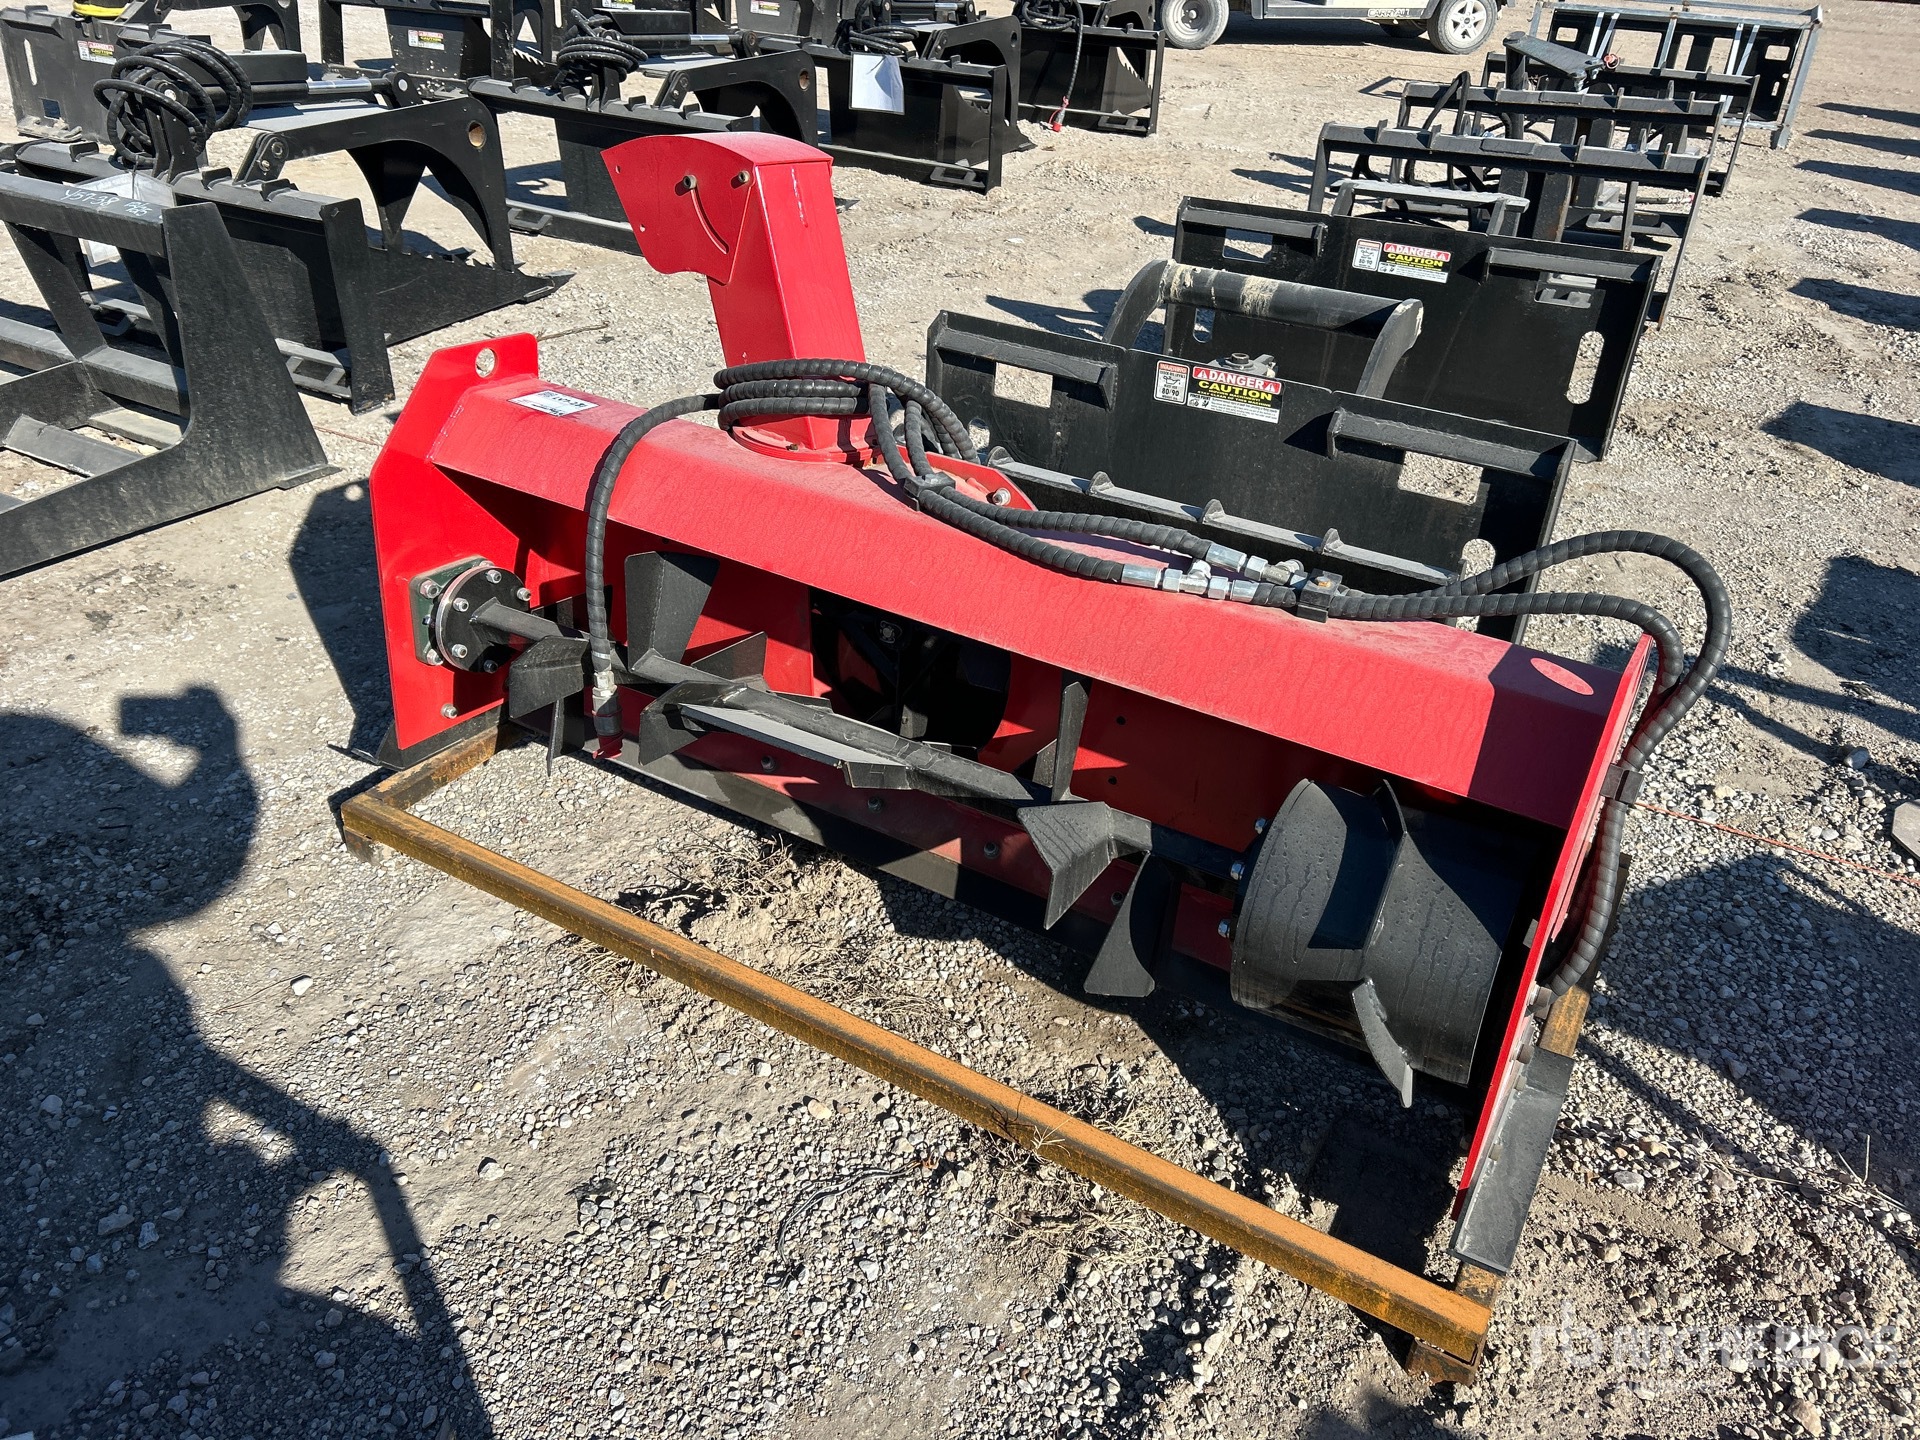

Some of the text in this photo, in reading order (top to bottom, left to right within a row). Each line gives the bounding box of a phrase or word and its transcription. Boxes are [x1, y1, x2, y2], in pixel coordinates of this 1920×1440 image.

[1387, 252, 1444, 267] CAUTION
[1396, 245, 1438, 259] DANGER
[1208, 369, 1266, 390] DANGER
[1161, 387, 1180, 397] 80/90
[1198, 380, 1273, 401] CAUTION
